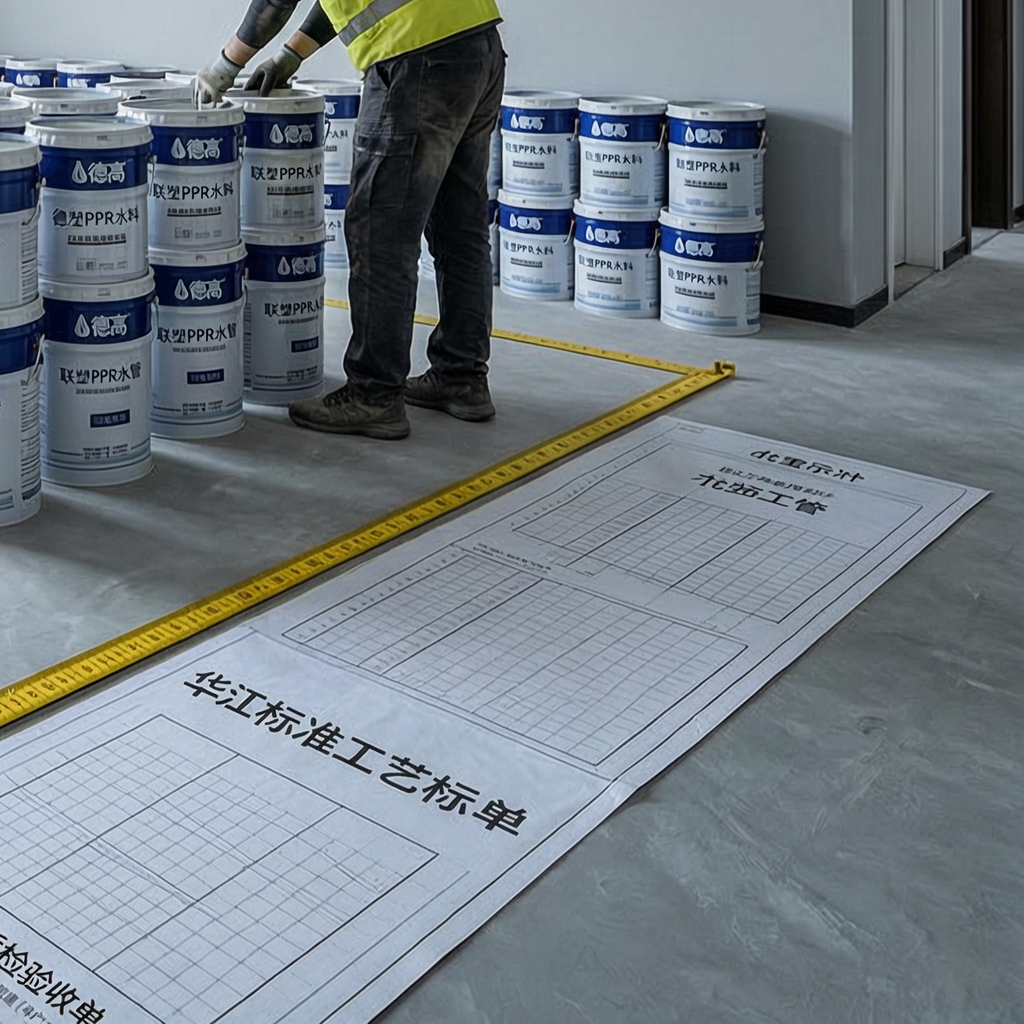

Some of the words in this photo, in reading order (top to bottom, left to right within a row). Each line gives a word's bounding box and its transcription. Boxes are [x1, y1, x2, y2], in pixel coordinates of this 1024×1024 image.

[183, 671, 528, 837] 华江标准工艺标单
